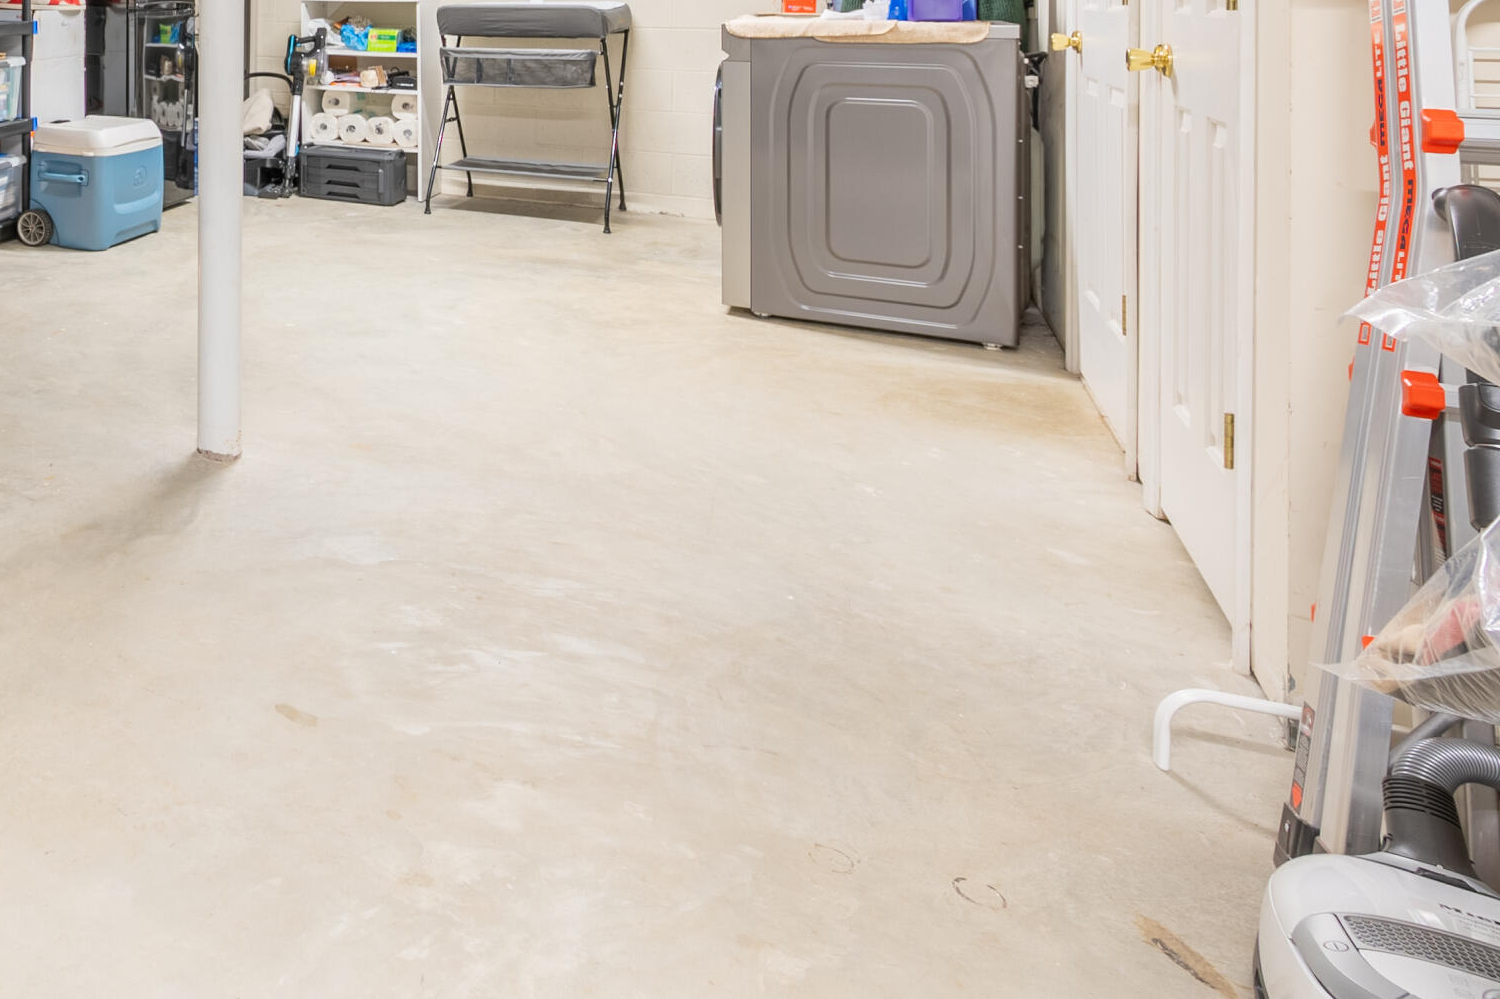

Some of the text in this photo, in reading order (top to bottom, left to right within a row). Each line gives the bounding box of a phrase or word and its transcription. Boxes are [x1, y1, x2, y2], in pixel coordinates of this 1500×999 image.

[1394, 23, 1408, 92] Little
[1400, 100, 1414, 170] Giant
[1366, 229, 1384, 297] Little
[1377, 154, 1390, 222] Giant
[1394, 179, 1414, 281] MEGALIT
